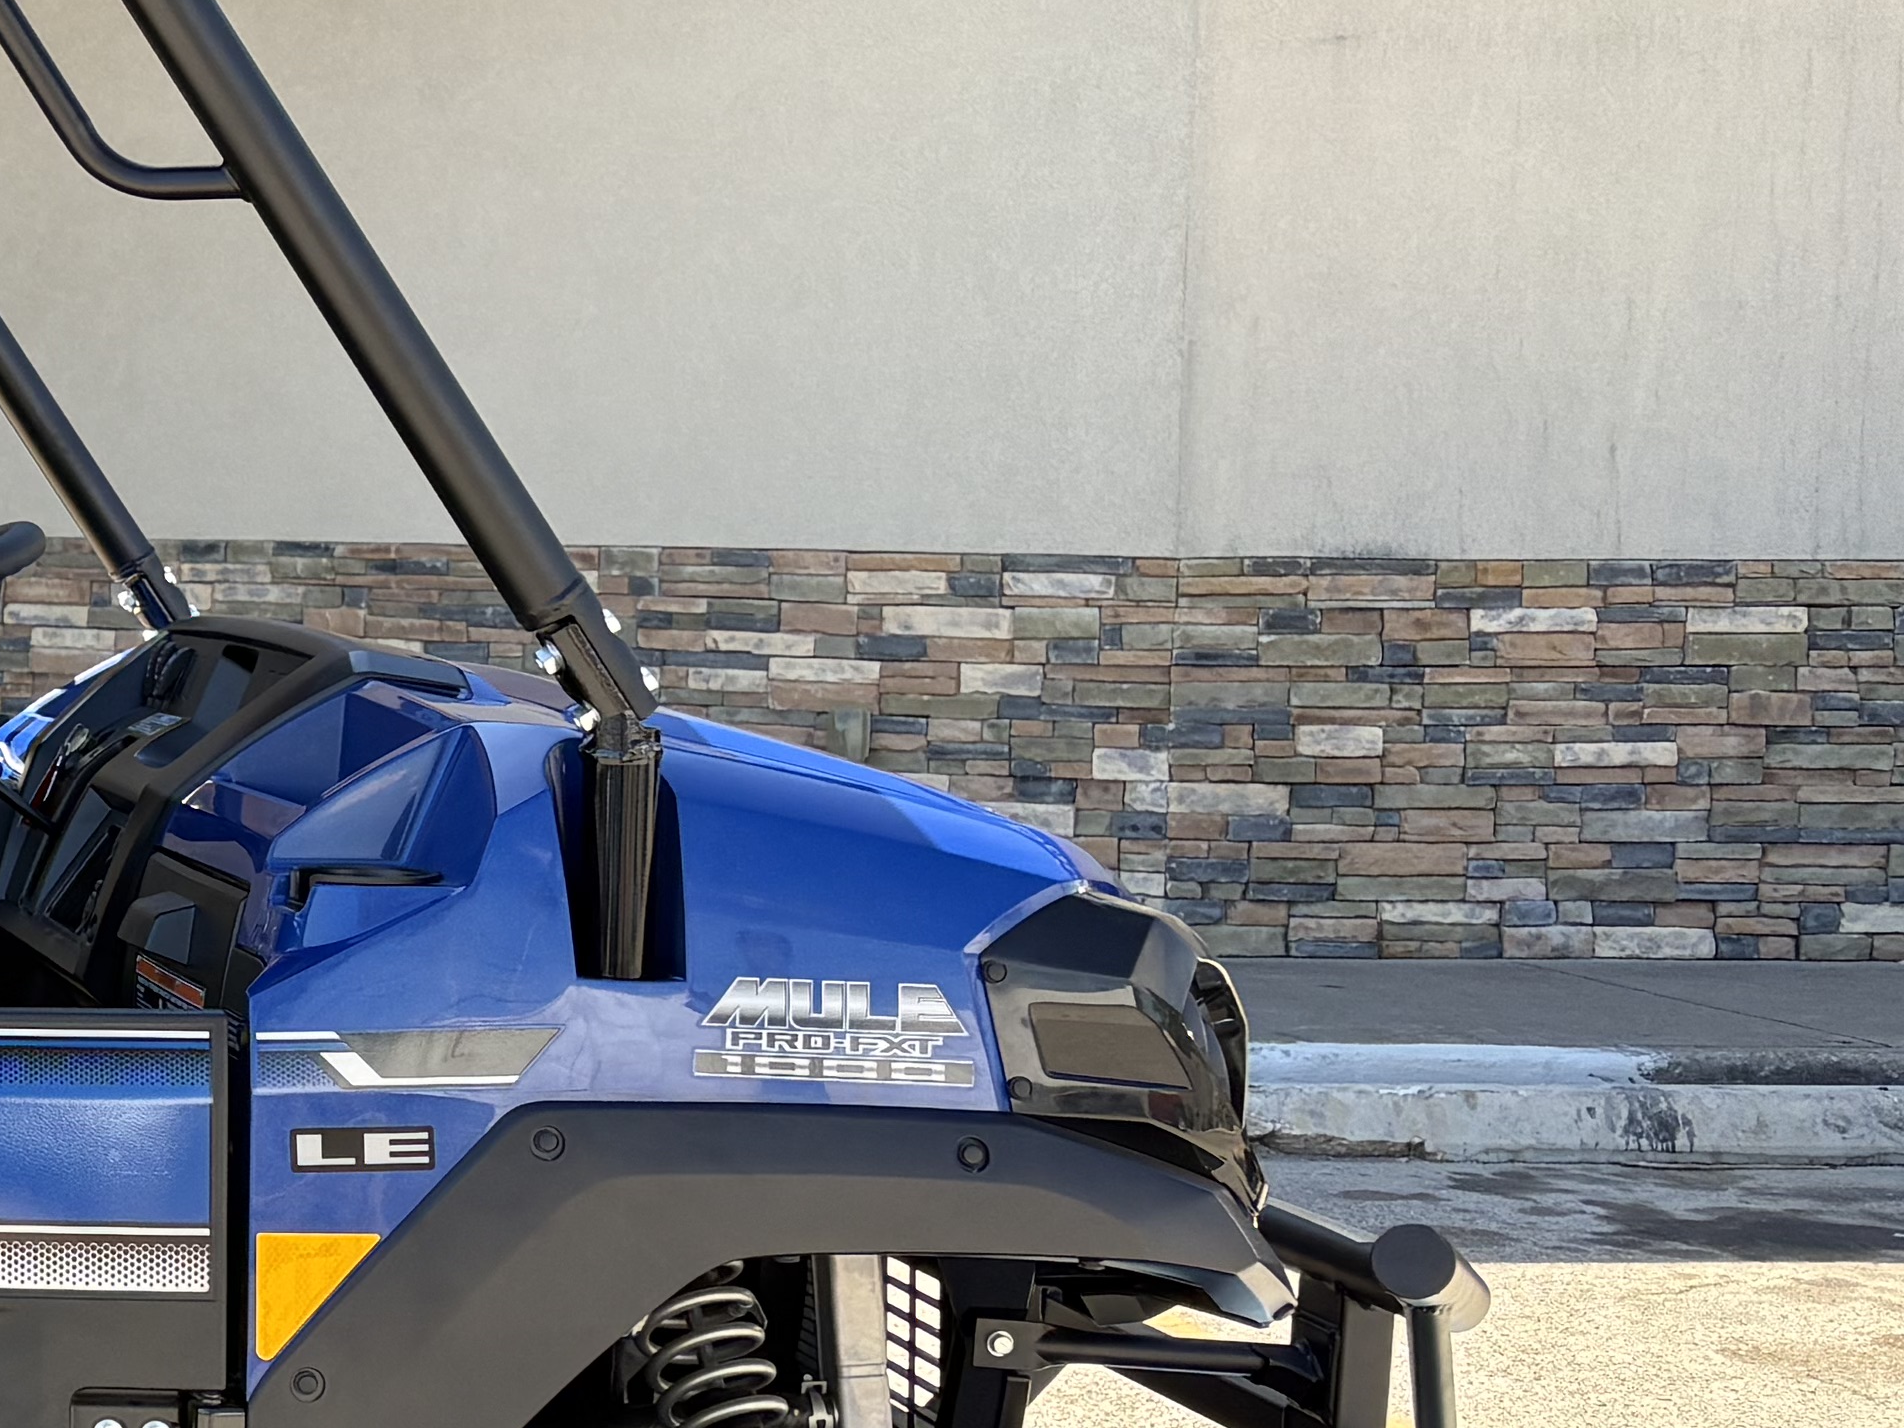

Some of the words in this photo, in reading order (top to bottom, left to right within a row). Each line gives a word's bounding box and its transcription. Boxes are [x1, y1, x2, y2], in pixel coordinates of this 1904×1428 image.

[701, 976, 970, 1037] MULE
[725, 1028, 944, 1058] PRO-FXT
[721, 1054, 947, 1080] 1000
[296, 1130, 432, 1169] LE
